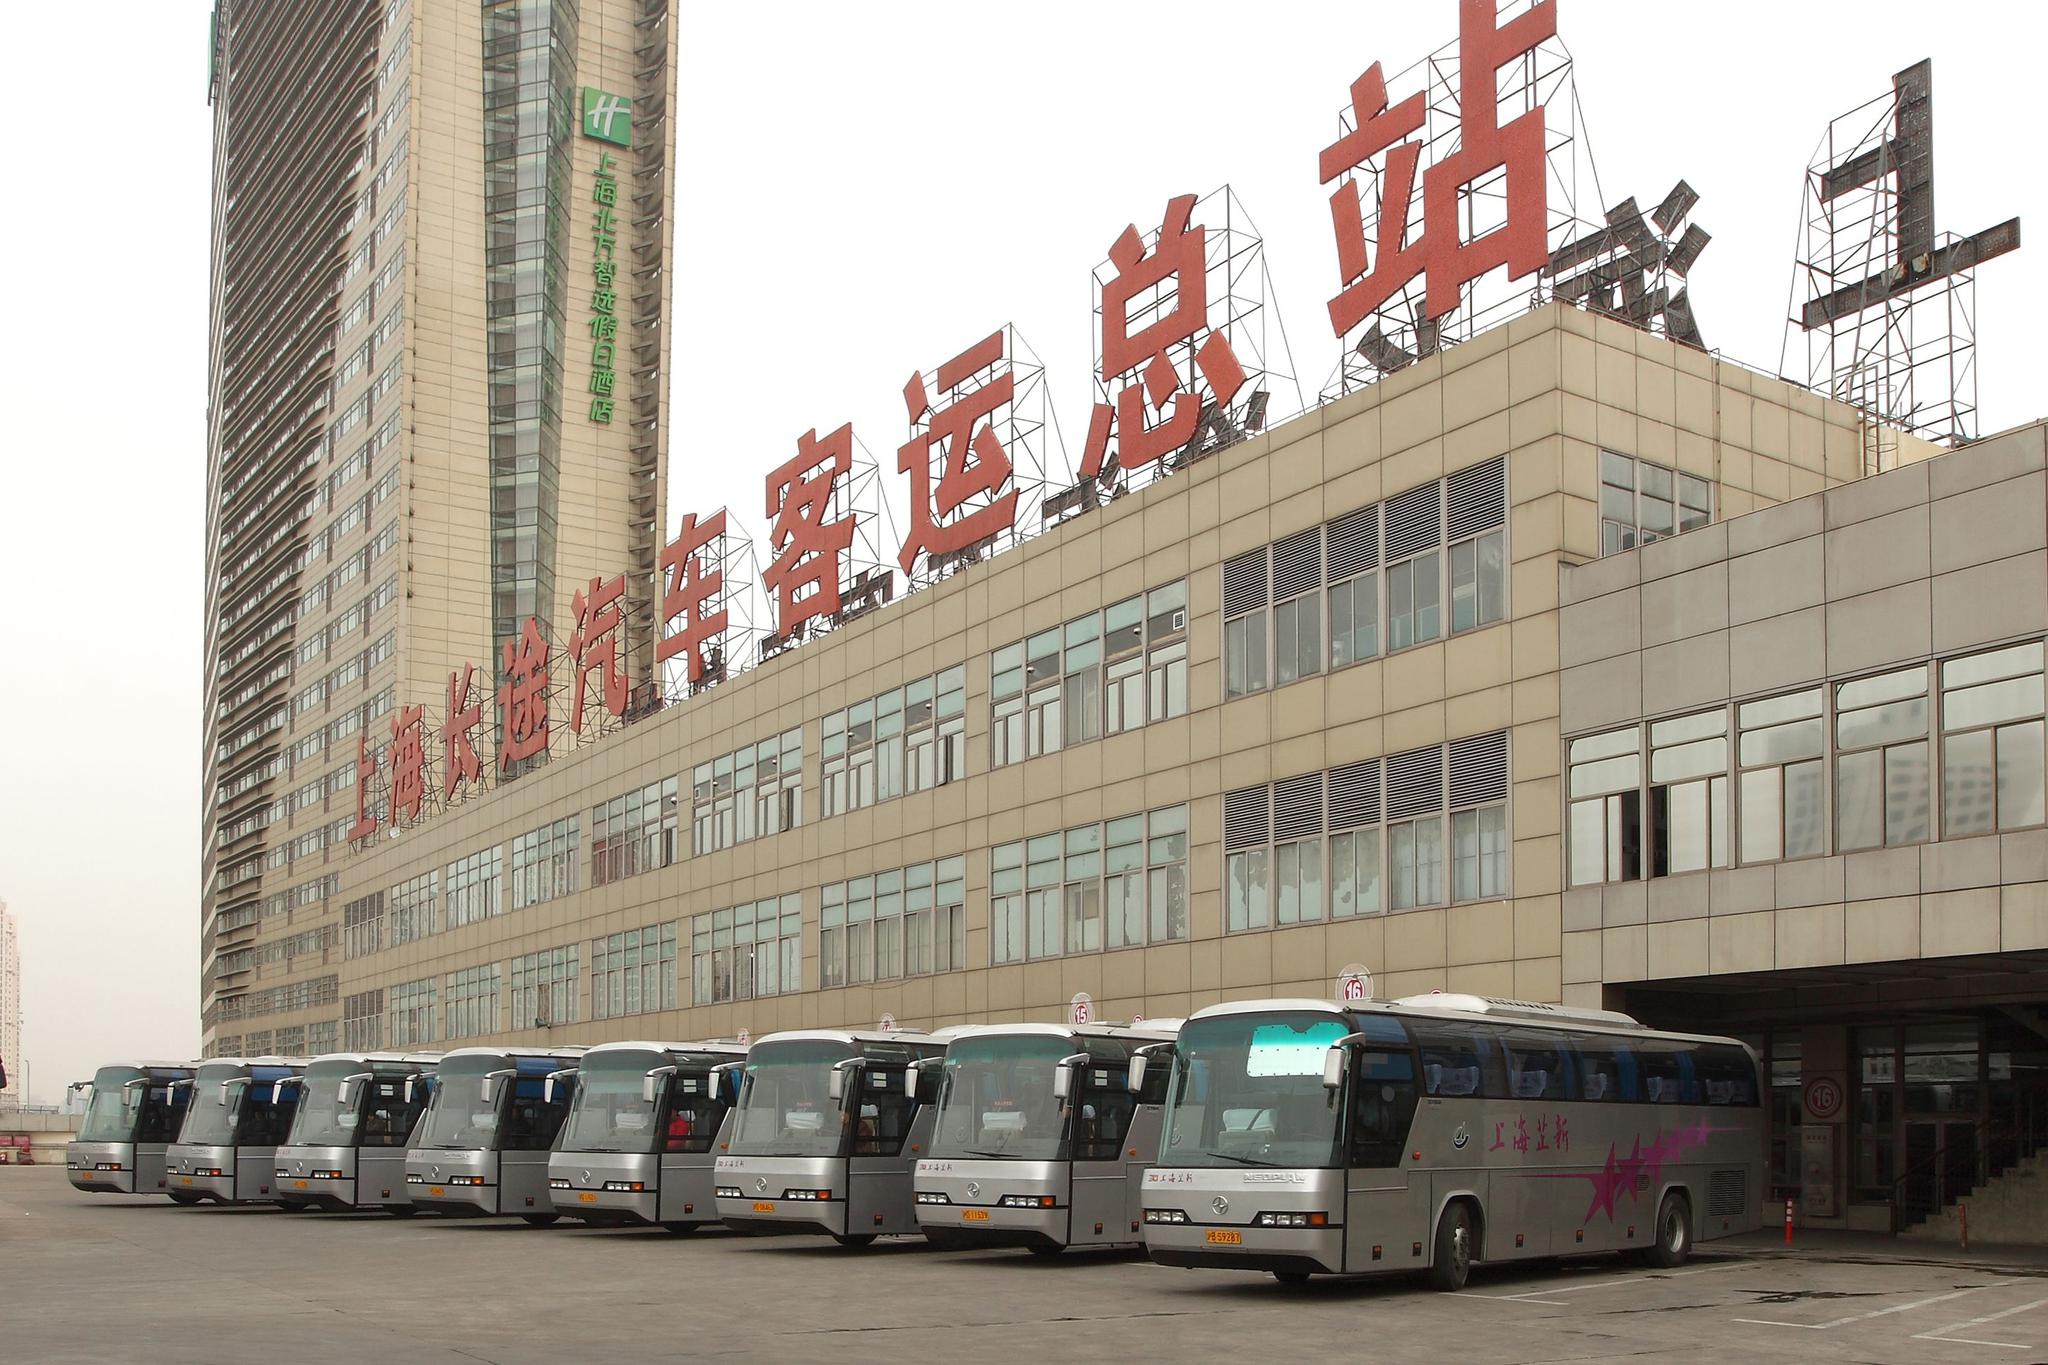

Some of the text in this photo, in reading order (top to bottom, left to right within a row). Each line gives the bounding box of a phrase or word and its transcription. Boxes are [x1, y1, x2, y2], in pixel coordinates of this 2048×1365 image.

[588, 151, 618, 425] 上海北方智选假日酒店
[348, 0, 1558, 845] 上海长途汽车客运总站
[1345, 981, 1362, 1001] 16
[1075, 1008, 1088, 1025] 15
[1812, 1088, 1833, 1108] 16
